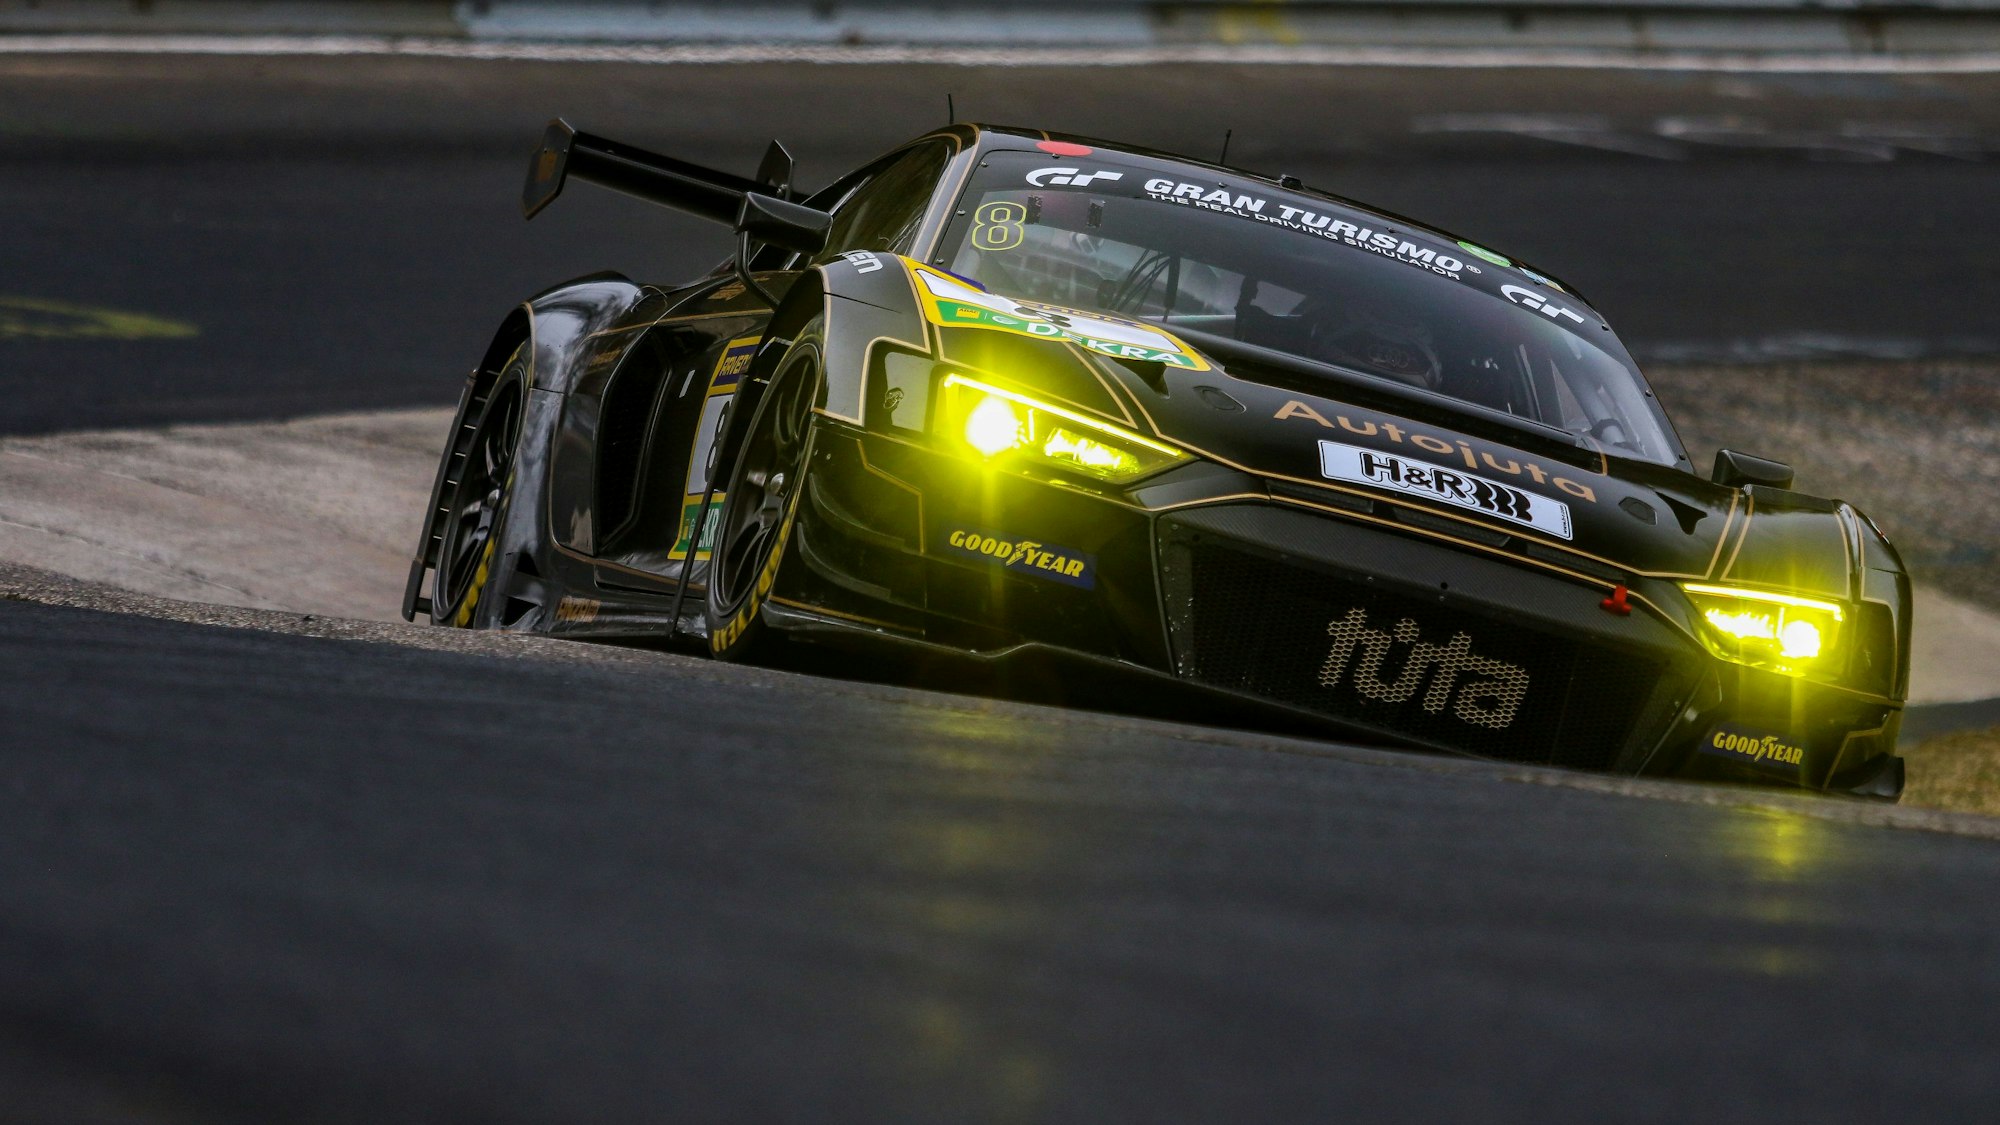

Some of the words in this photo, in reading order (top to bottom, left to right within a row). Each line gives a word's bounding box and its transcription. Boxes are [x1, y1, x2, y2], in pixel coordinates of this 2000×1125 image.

[1144, 178, 1267, 213] GRAN
[971, 201, 1028, 251] 8
[1147, 192, 1188, 206] THE
[1195, 201, 1250, 218] REAL
[1254, 213, 1339, 241] DRIVING
[1344, 237, 1461, 281] SIMULATOR
[1026, 322, 1184, 365] DEKRA
[1273, 400, 1598, 504] Autojuta
